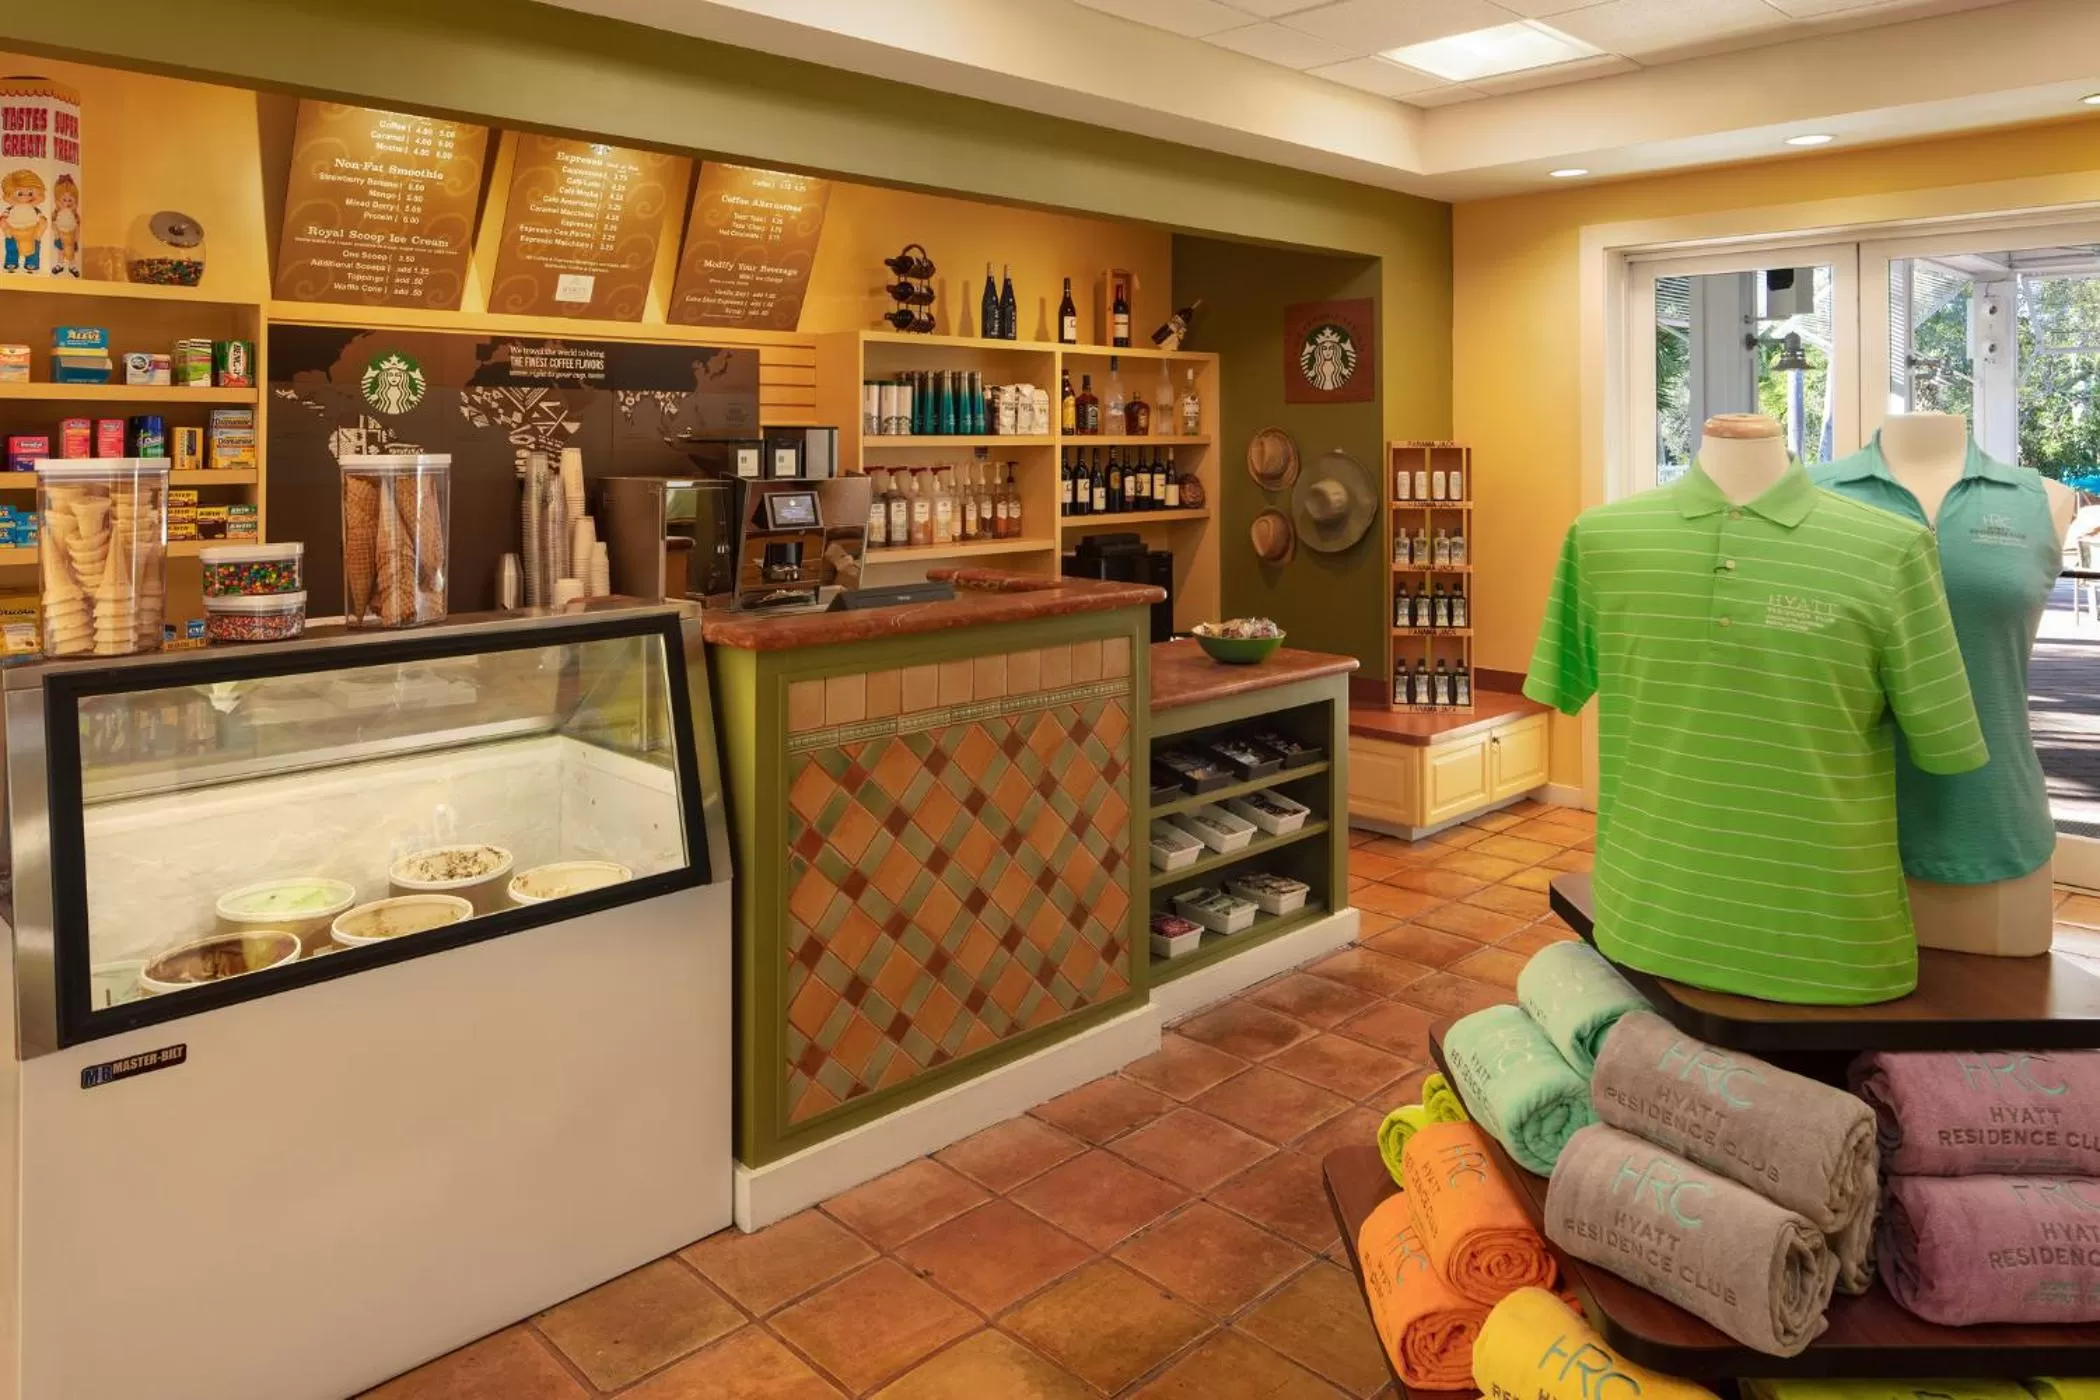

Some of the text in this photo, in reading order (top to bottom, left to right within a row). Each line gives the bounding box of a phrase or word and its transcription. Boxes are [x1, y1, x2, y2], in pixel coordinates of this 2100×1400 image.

[1, 106, 47, 132] TASTES
[54, 110, 79, 140] SUPER
[1, 133, 46, 159] GREAT!
[319, 172, 365, 186] Strawberry
[334, 158, 444, 180] Non-Fat Smoothie
[345, 197, 370, 208] Mixed
[372, 200, 395, 213] Berry
[368, 189, 396, 201] Mango
[308, 225, 345, 239] Royal
[349, 230, 385, 244] Scoop
[390, 235, 407, 244] Ice
[411, 235, 449, 248] Cream
[310, 258, 354, 269] Additional
[342, 249, 360, 258] One
[362, 252, 388, 262] Scoop
[703, 259, 735, 271] Modify
[738, 263, 757, 273] Your
[334, 282, 359, 292] Waffle
[361, 284, 383, 293] Cone
[347, 272, 384, 284] Toppings
[510, 345, 521, 355] We
[523, 347, 544, 356] travel
[544, 347, 556, 356] the
[558, 348, 578, 357] world
[586, 349, 605, 359] bring
[510, 355, 605, 371] THE FINEST COFFEE FLAVORS
[1408, 440, 1455, 448] PANAMA JACK
[1408, 628, 1457, 636] PANAMA JACK
[113, 1045, 184, 1075] MASTER-BILT
[1656, 1039, 1767, 1110] HRC
[1953, 1051, 2070, 1096] HRC
[1656, 1083, 1727, 1127] HYATT
[1989, 1106, 2061, 1126] HYATT
[1603, 1085, 1782, 1185] RESIDENCE CLUB
[1938, 1129, 2058, 1147] RESIDENCE
[1611, 1154, 1712, 1229] HRC
[1613, 1209, 1681, 1252] HYATT
[1563, 1218, 1673, 1275] RESIDENCE
[1678, 1264, 1738, 1307] CLUB
